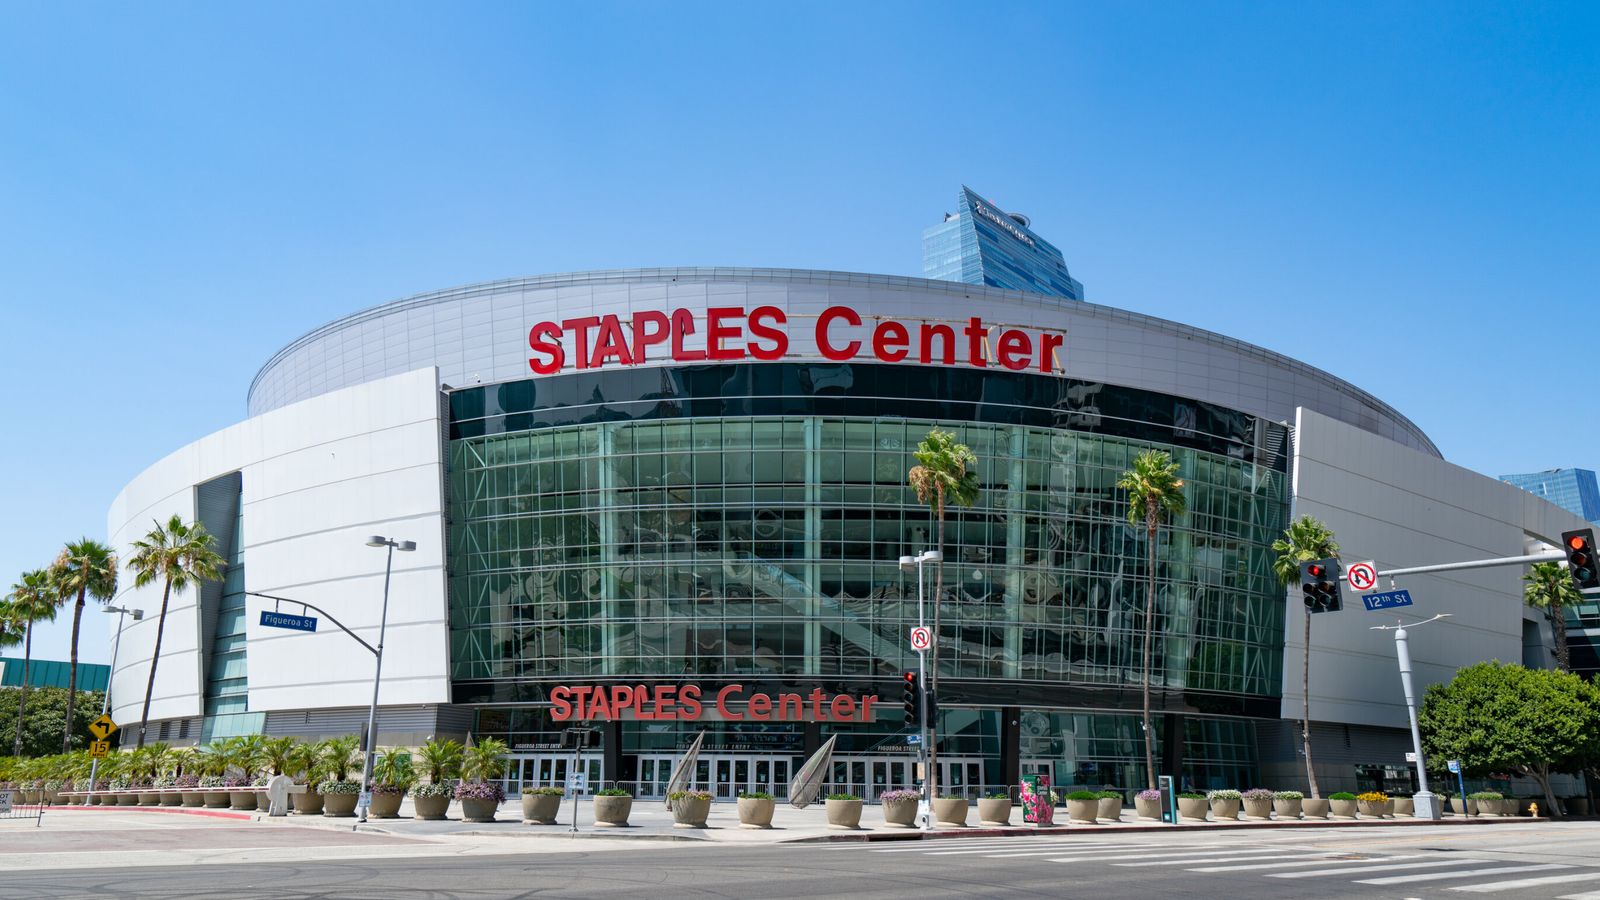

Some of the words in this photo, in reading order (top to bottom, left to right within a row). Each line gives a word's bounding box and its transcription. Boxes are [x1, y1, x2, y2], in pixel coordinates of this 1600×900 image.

[529, 306, 789, 374] STAPLES
[815, 306, 1063, 373] Center
[1368, 596, 1390, 608] 12th
[1394, 594, 1407, 603] St
[265, 614, 301, 627] Figueroa
[304, 619, 313, 628] St
[550, 684, 702, 720] STAPLES
[716, 684, 878, 720] Center
[95, 743, 106, 753] 15
